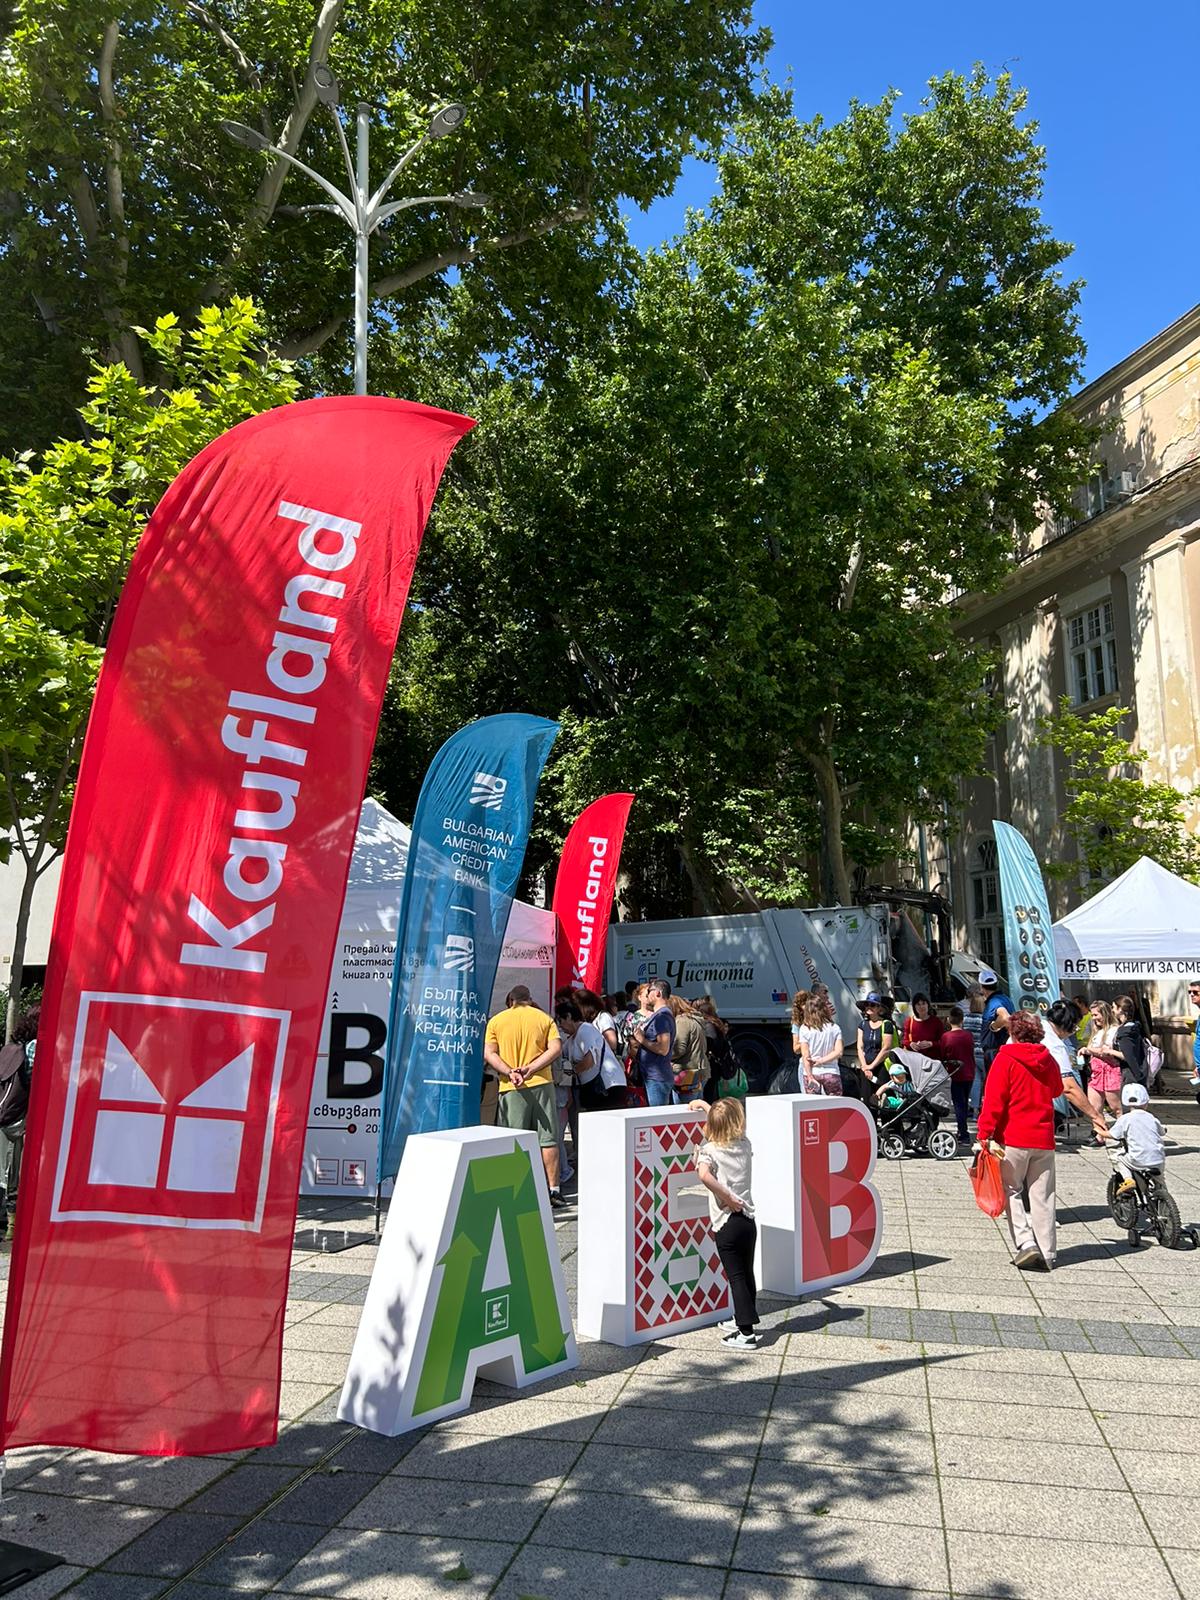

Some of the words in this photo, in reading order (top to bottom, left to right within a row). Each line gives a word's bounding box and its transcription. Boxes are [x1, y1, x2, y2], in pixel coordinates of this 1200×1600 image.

[179, 500, 362, 974] Kaufland
[442, 817, 515, 846] BULGARIAN
[442, 835, 508, 860] AMERICAN
[451, 852, 494, 872] CREDIT
[455, 869, 485, 888] BANK
[571, 836, 608, 990] Kaufland
[343, 945, 379, 956] Предай
[342, 970, 371, 980] книга
[372, 972, 385, 980] по
[666, 959, 754, 988] Чистота
[1115, 961, 1155, 974] КНИГИ
[1158, 961, 1174, 974] ЗА
[427, 1039, 474, 1055] БАНКА
